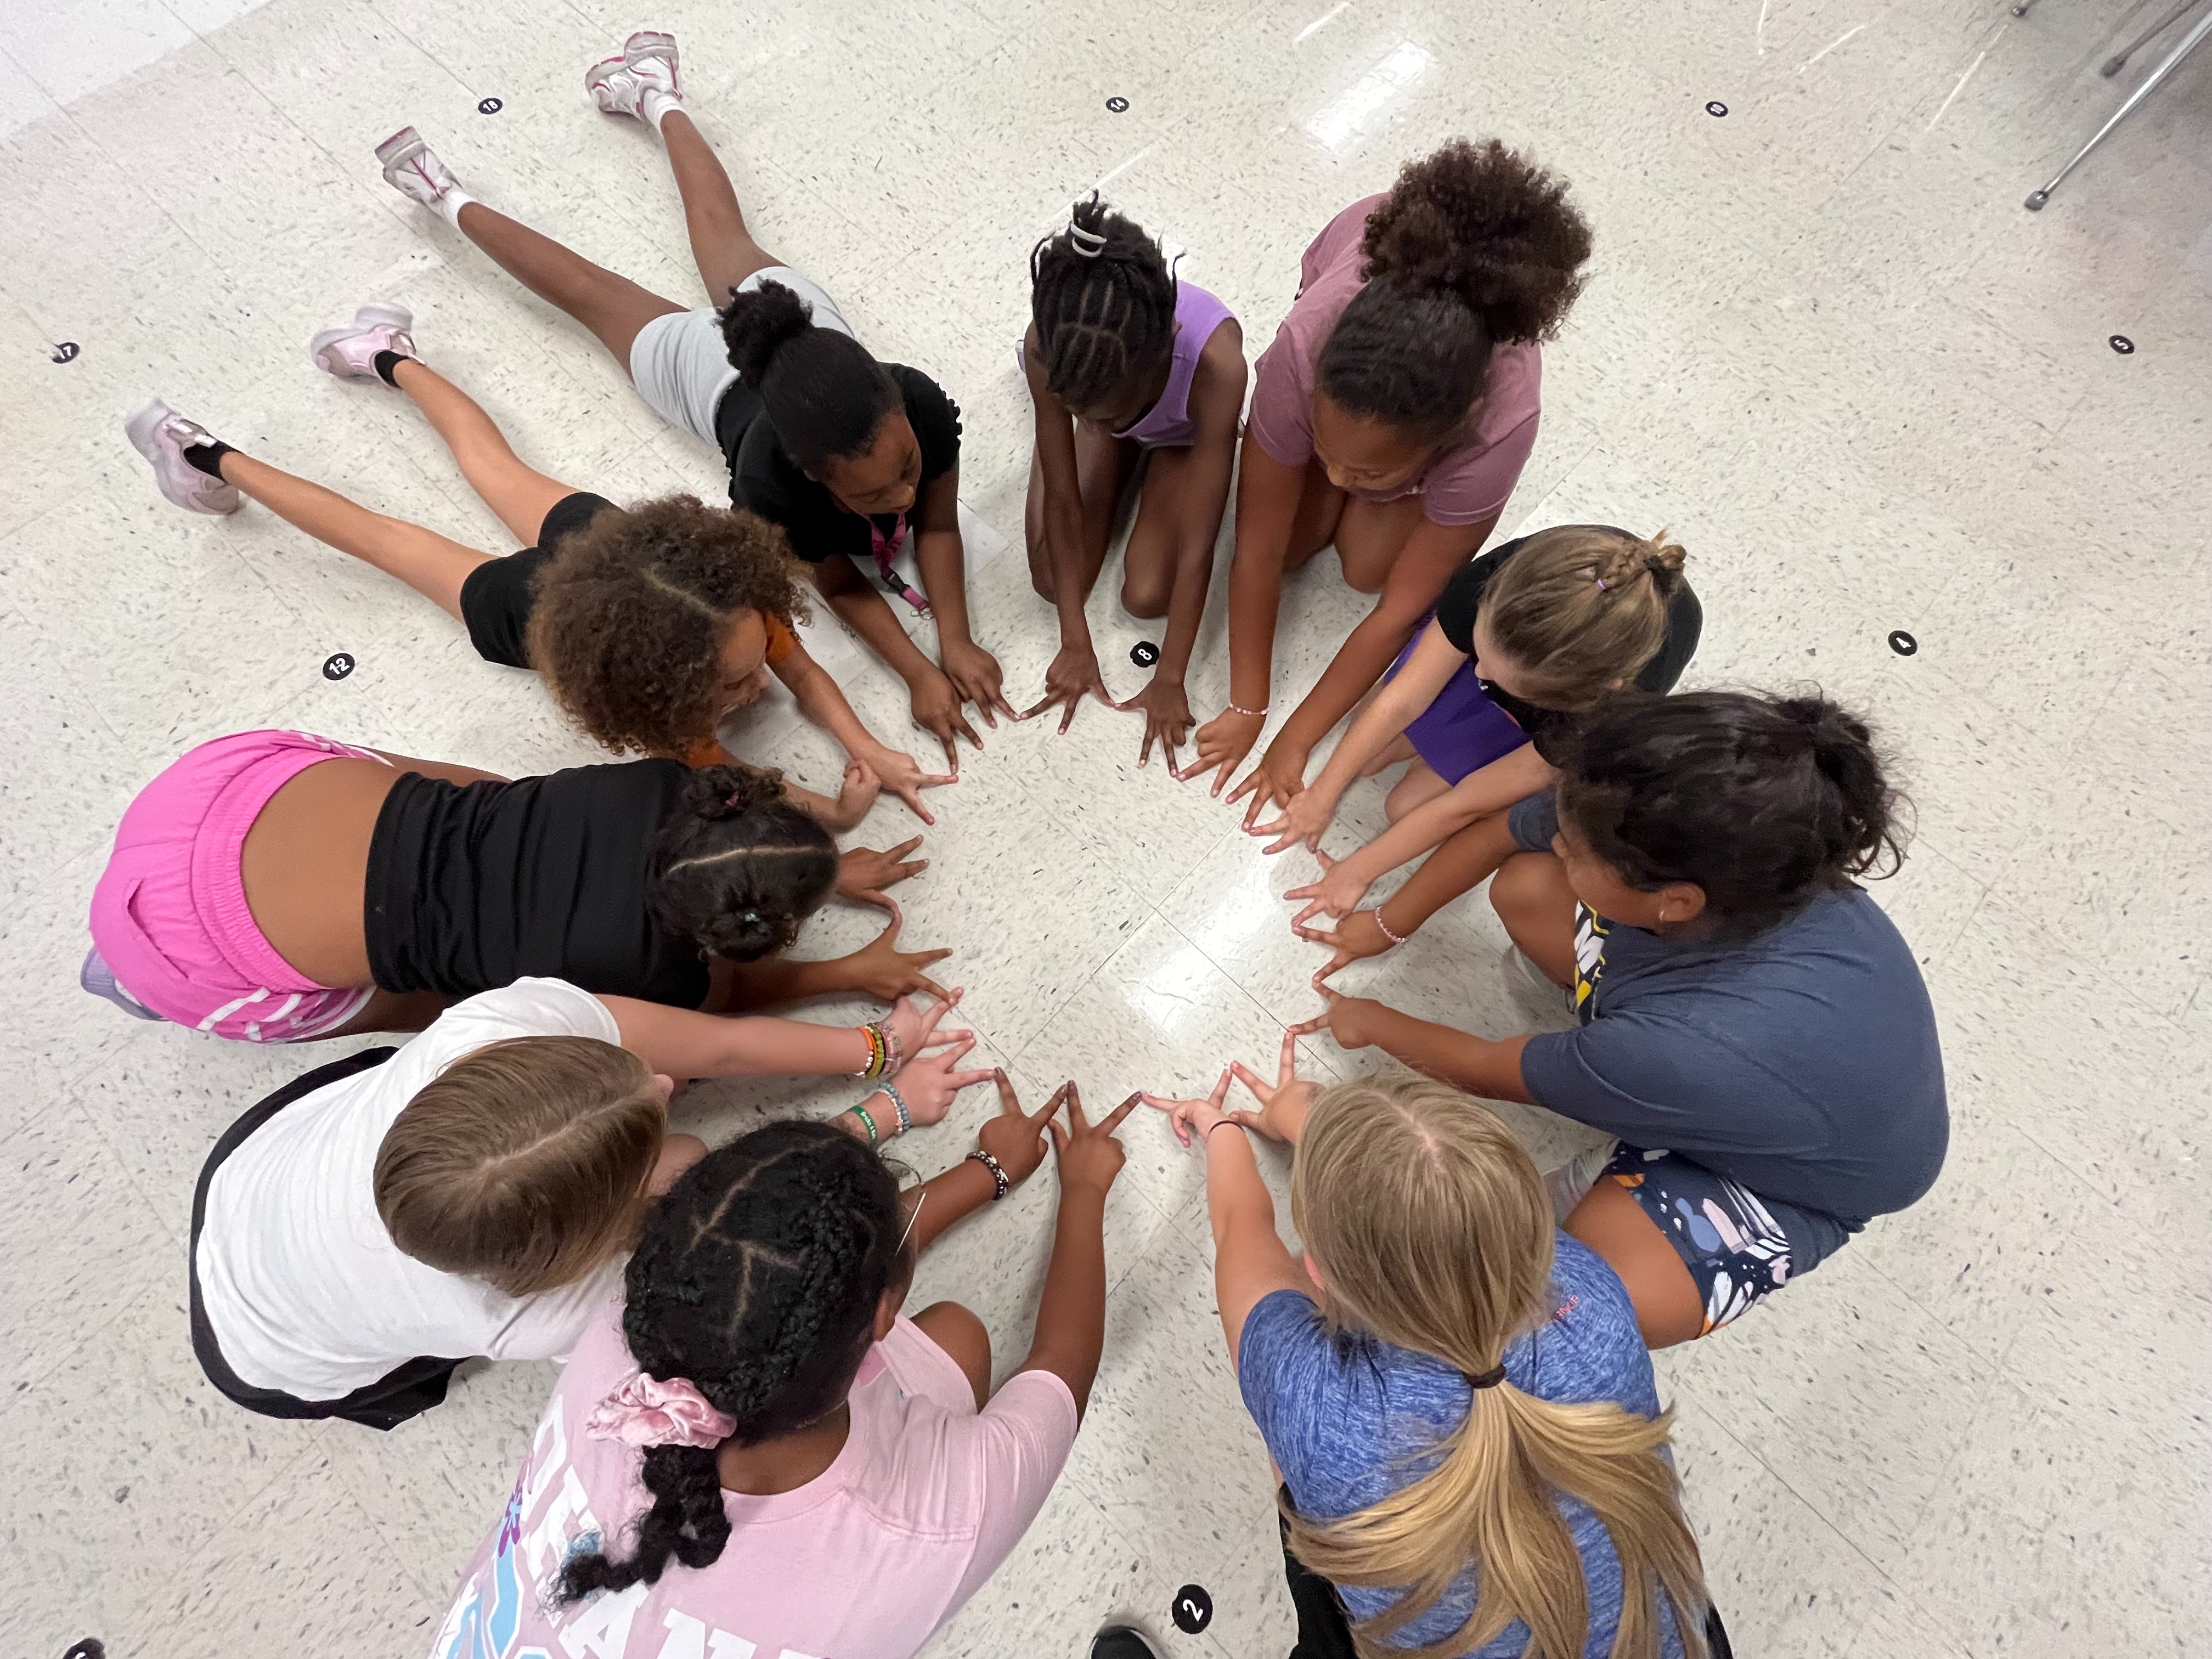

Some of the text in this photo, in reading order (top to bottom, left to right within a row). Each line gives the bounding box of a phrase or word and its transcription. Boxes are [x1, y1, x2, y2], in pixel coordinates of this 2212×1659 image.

[1110, 99, 1125, 110] 14
[1710, 104, 1724, 114] 10
[2114, 340, 2129, 350] 5
[60, 346, 72, 359] 17
[1895, 637, 1911, 648] 4
[1138, 648, 1152, 661] 8
[329, 657, 350, 675] 12
[1182, 1599, 1204, 1621] 2
